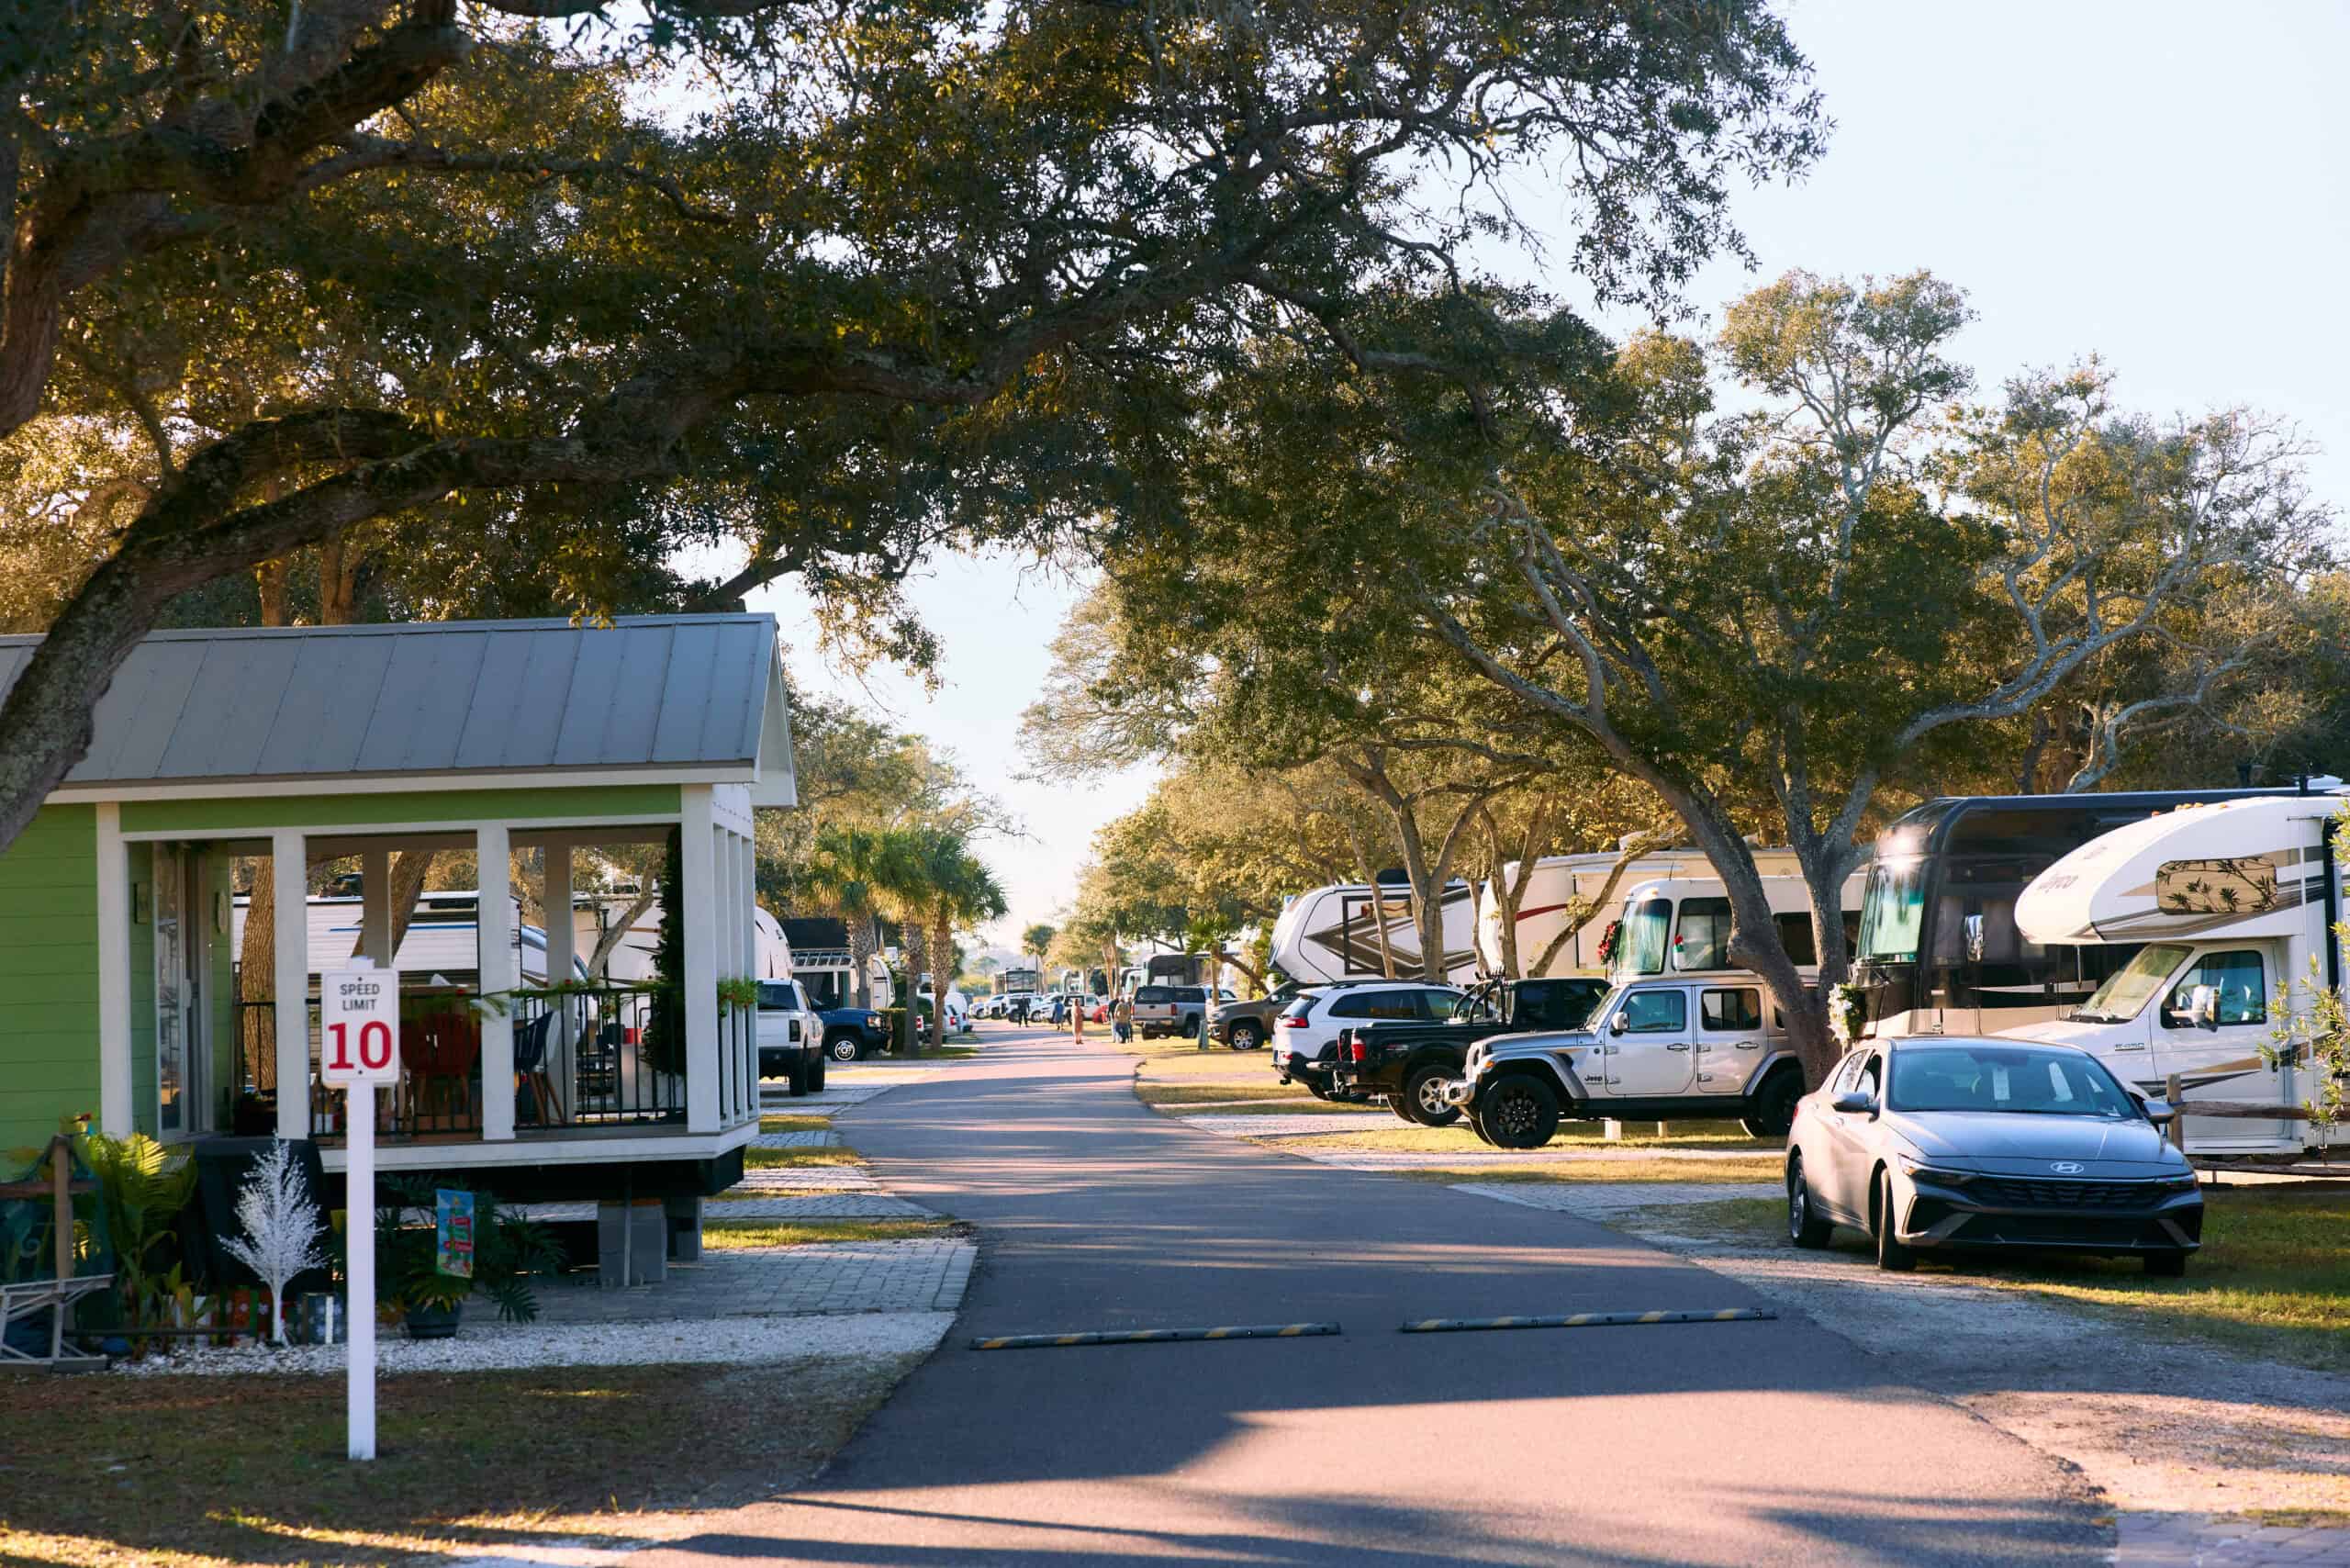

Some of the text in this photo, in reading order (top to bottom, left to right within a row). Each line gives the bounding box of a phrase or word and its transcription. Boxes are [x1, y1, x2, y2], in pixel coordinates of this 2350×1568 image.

[340, 983, 380, 996] SPEED
[342, 999, 377, 1012] LIMIT
[328, 1020, 392, 1070] 10
